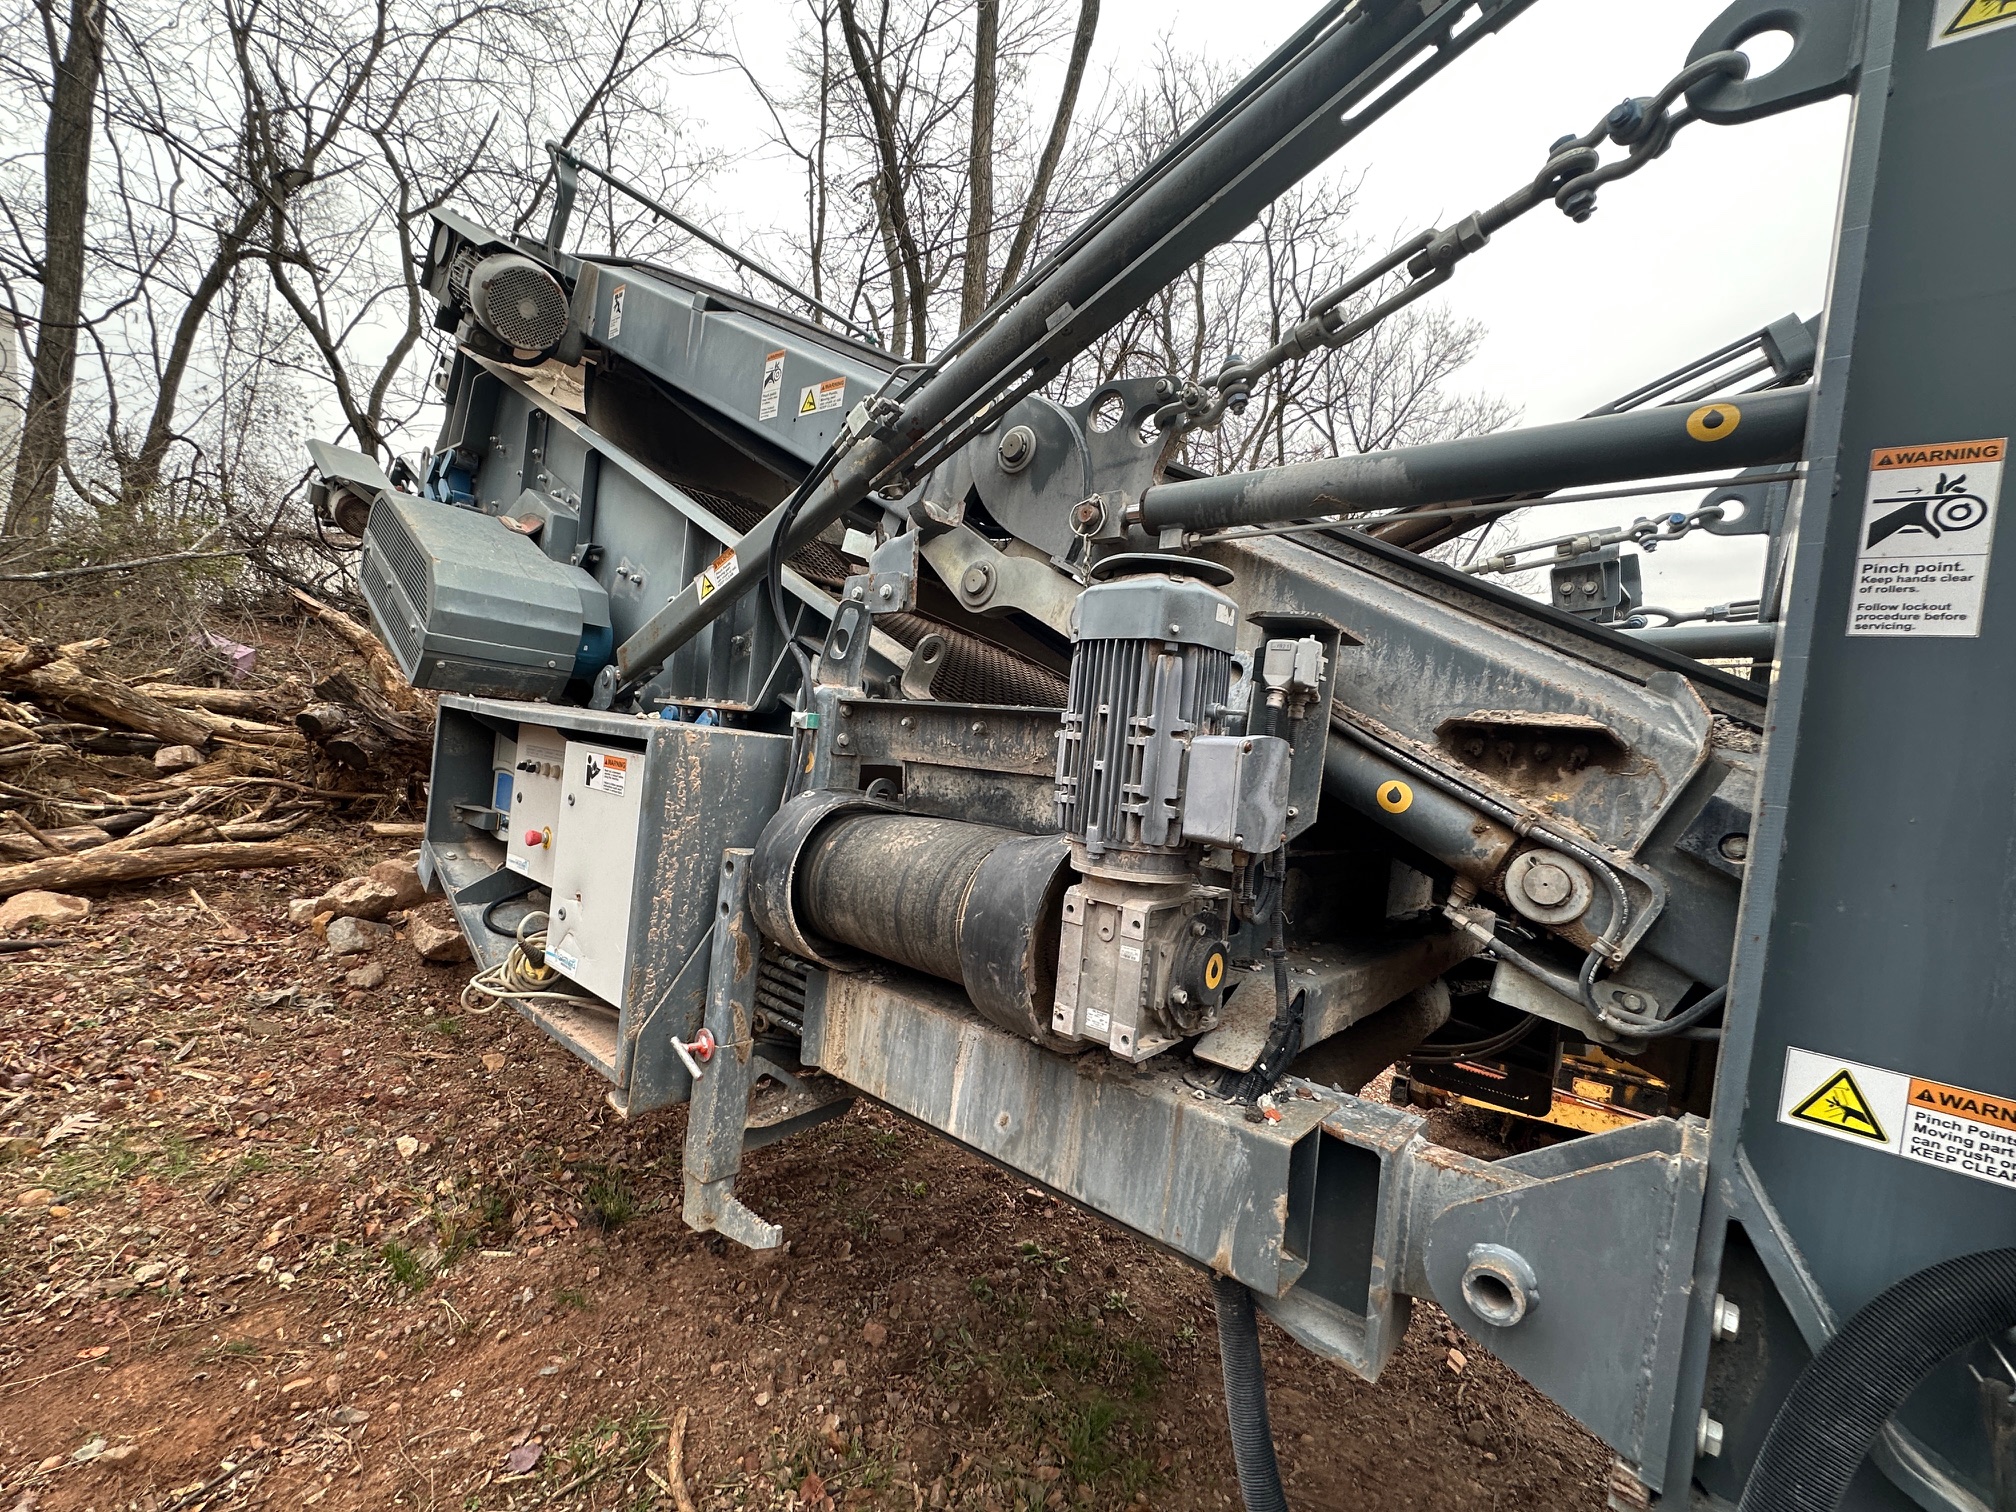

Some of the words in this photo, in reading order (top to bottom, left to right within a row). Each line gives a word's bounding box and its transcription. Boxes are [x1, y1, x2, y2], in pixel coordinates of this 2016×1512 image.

[1897, 445, 1999, 465] WARNING
[1862, 563, 1910, 574] Pinch
[1914, 561, 1966, 575] point.
[1860, 575, 1893, 585] Keep
[1896, 574, 1937, 583] hands
[1940, 574, 1974, 582] clear
[1859, 585, 1873, 594] of
[1875, 585, 1920, 593] rollers.
[1857, 603, 1899, 611] Follow
[1902, 602, 1952, 611] lockout
[1855, 612, 1920, 622] procedure
[1924, 612, 1967, 621] before
[1854, 622, 1916, 632] servicing.
[1915, 1111, 1962, 1131] Pinch
[1913, 1122, 1974, 1149] Moving
[1979, 1142, 2015, 1158] part
[1910, 1145, 1957, 1164] KEEP
[1912, 1136, 1941, 1150] can
[1946, 1145, 1995, 1164] crush
